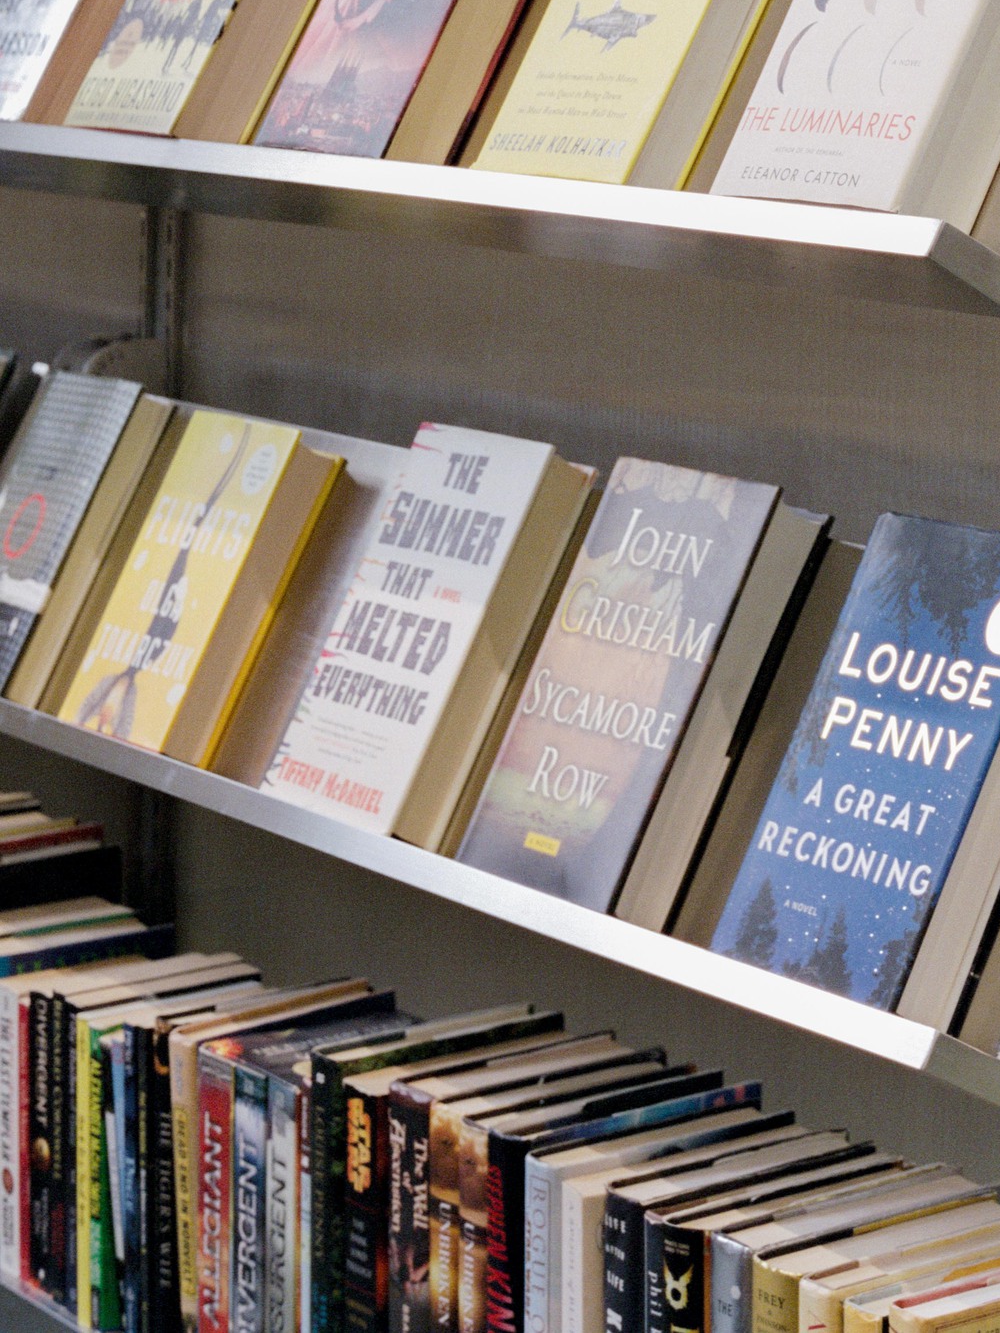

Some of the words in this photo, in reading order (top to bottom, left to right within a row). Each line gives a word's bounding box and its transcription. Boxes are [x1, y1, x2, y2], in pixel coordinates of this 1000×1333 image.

[741, 106, 780, 132] THE
[780, 107, 917, 141] LUMINARIES
[741, 165, 800, 183] ELEANOR
[803, 169, 861, 188] CATTON
[443, 451, 490, 495] THE
[144, 494, 252, 560] FLIGHTS
[378, 490, 506, 567] SUMMER
[611, 507, 715, 580] JOHN
[379, 561, 434, 601] THAT
[335, 599, 453, 677] MELTED
[558, 576, 717, 665] GRISHAM
[311, 663, 430, 726] EVERYTHING
[522, 667, 678, 753] SYCAMORE
[818, 696, 975, 772] PENNY
[525, 745, 609, 810] ROW
[803, 777, 825, 809] A
[833, 783, 938, 837] GREAT
[756, 820, 933, 898] RECKONING
[783, 898, 791, 908] A
[791, 900, 818, 917] NOVEL
[34, 999, 50, 1129] DIVERGENT
[159, 1111, 172, 1149] THE
[413, 1137, 428, 1178] The
[158, 1158, 173, 1236] TIGER'S
[389, 1115, 406, 1234] Ascension
[412, 1182, 428, 1230] Well
[202, 1110, 223, 1331] ALLEGIANT
[237, 1139, 259, 1333] IVERGENT
[268, 1154, 288, 1333] SURGENT
[486, 1165, 509, 1262] STEPHEN
[604, 1212, 626, 1234] LIFE
[159, 1241, 173, 1291] WIFE
[437, 1201, 452, 1326] UNBROKEN
[463, 1221, 477, 1333] UNBROKE
[606, 1270, 624, 1293] LIFE
[486, 1265, 516, 1333] KIN
[717, 1299, 734, 1318] THE
[757, 1288, 785, 1310] FREY
